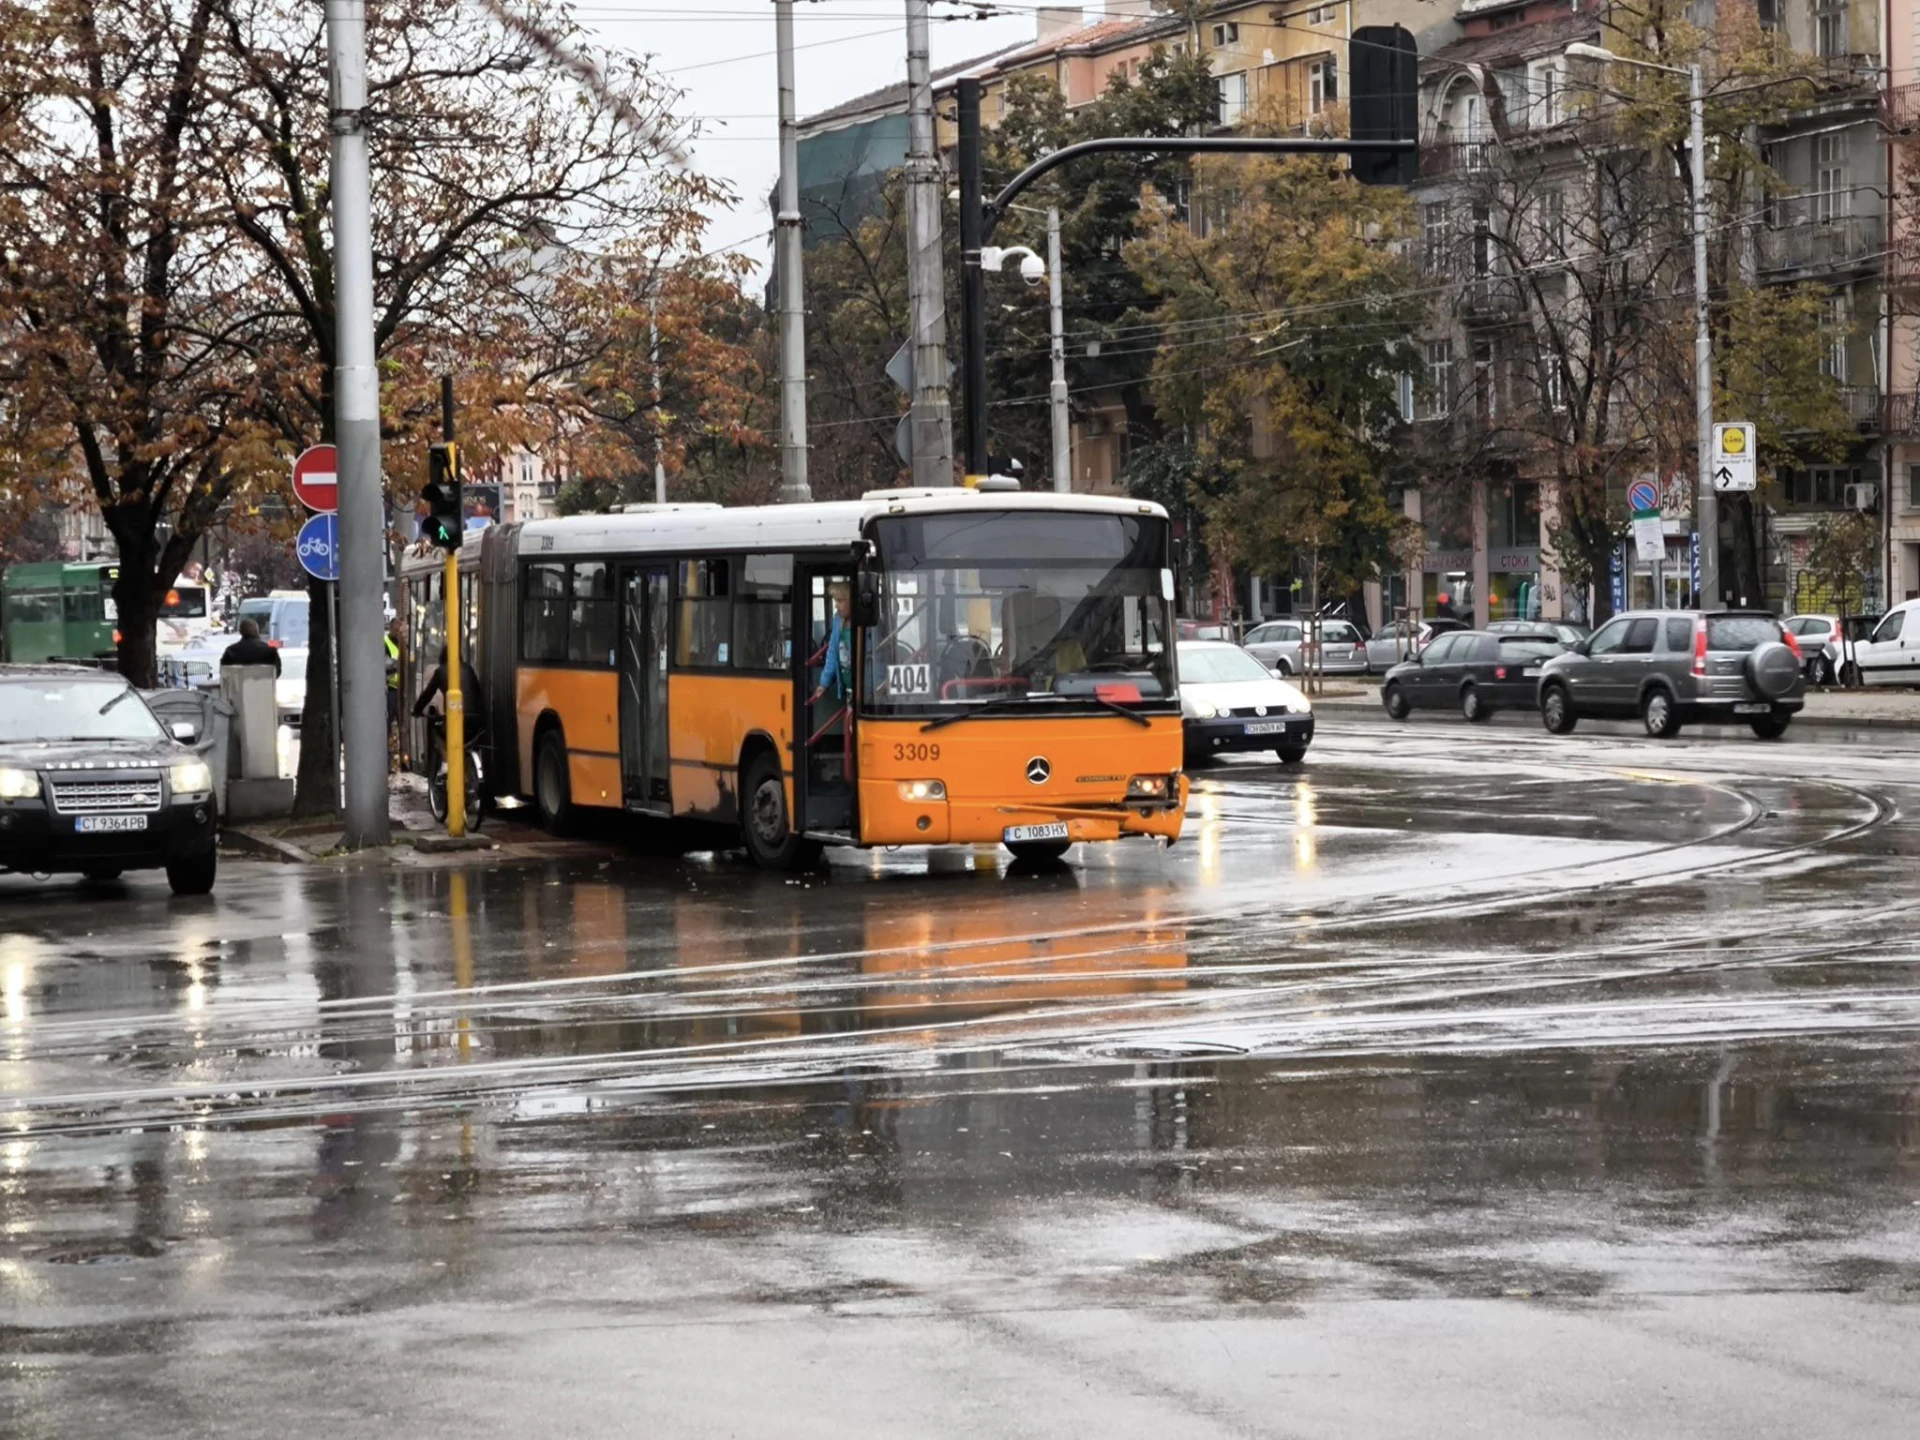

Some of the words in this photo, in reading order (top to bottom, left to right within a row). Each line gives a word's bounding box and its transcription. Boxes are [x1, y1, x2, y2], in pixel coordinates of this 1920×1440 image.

[1501, 556, 1529, 568] СТОКИ
[890, 666, 927, 692] 404
[893, 743, 940, 761] 3309
[100, 817, 128, 829] 9364
[1014, 827, 1021, 839] C
[1027, 824, 1051, 838] 1083
[1052, 822, 1066, 835] HX
